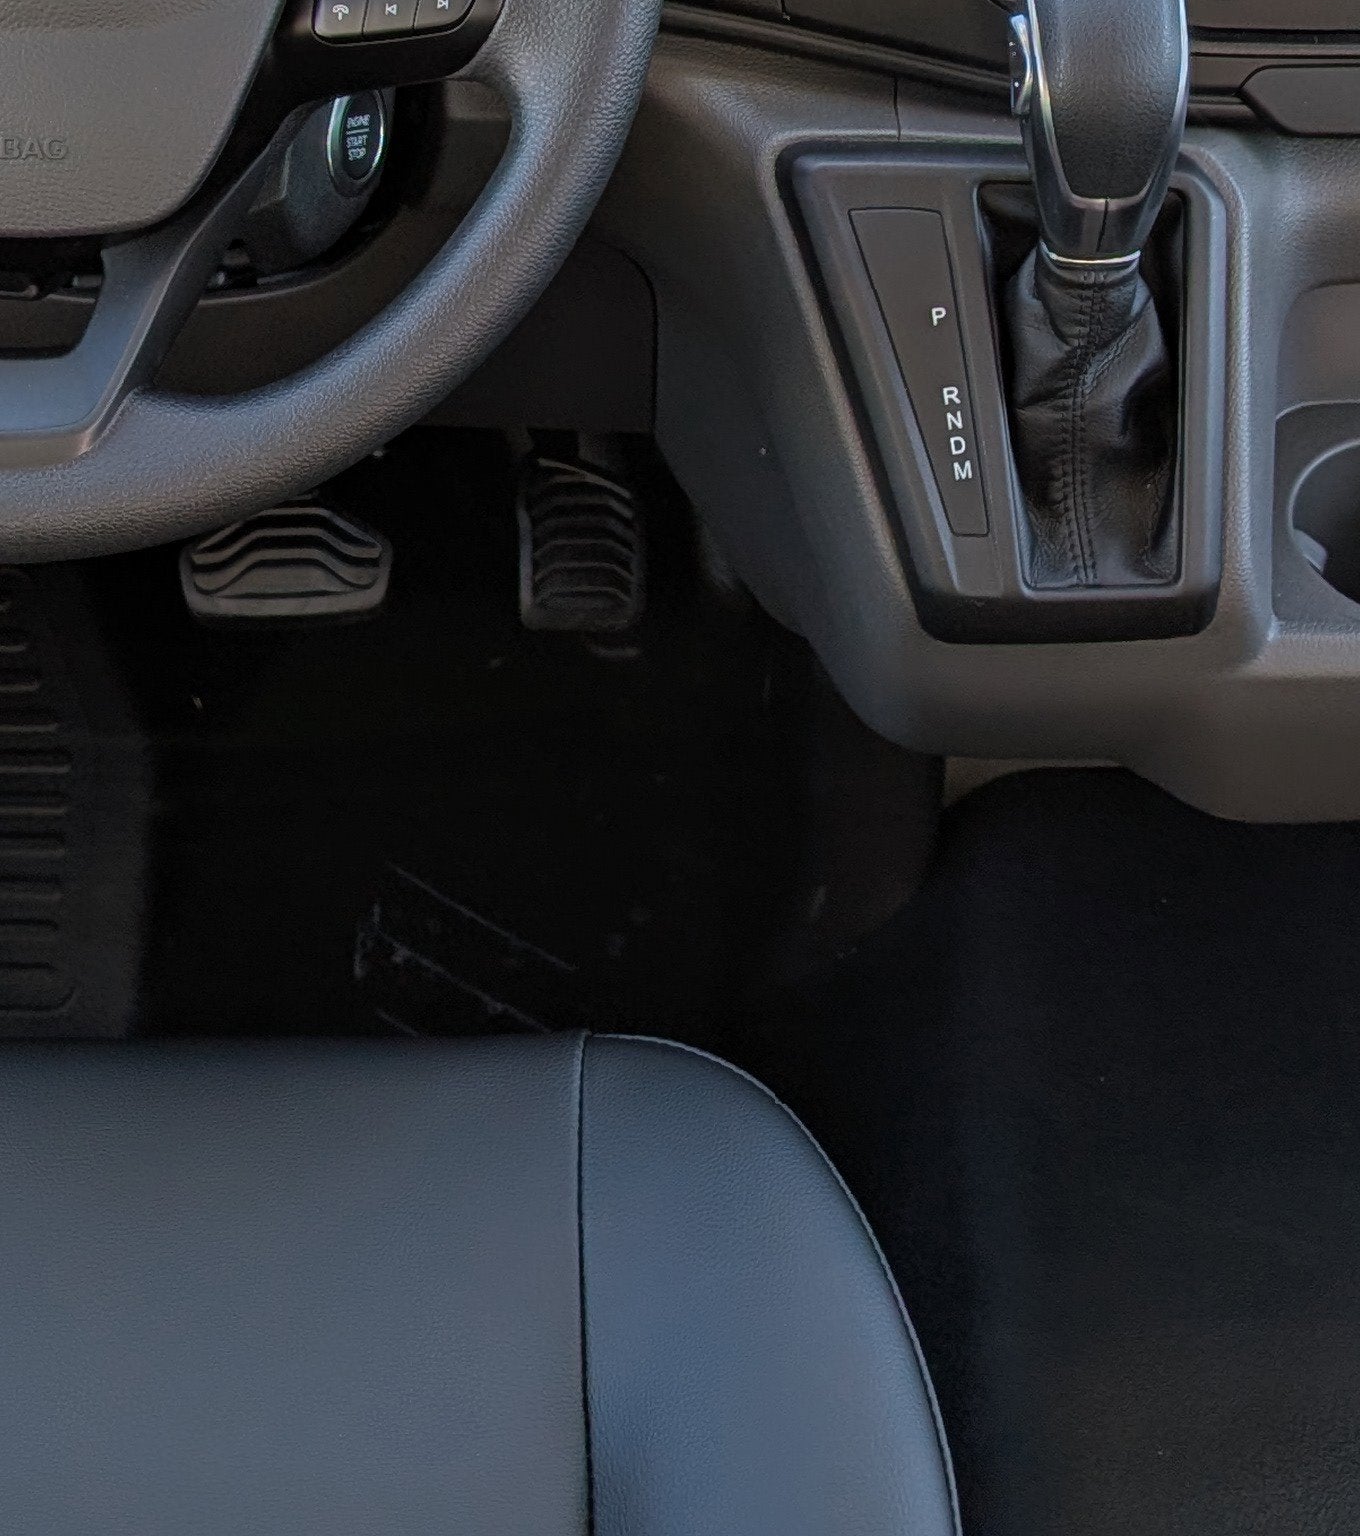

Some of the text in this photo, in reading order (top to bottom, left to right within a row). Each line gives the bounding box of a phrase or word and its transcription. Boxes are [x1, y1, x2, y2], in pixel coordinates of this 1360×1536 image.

[930, 306, 973, 481] P R N D M
